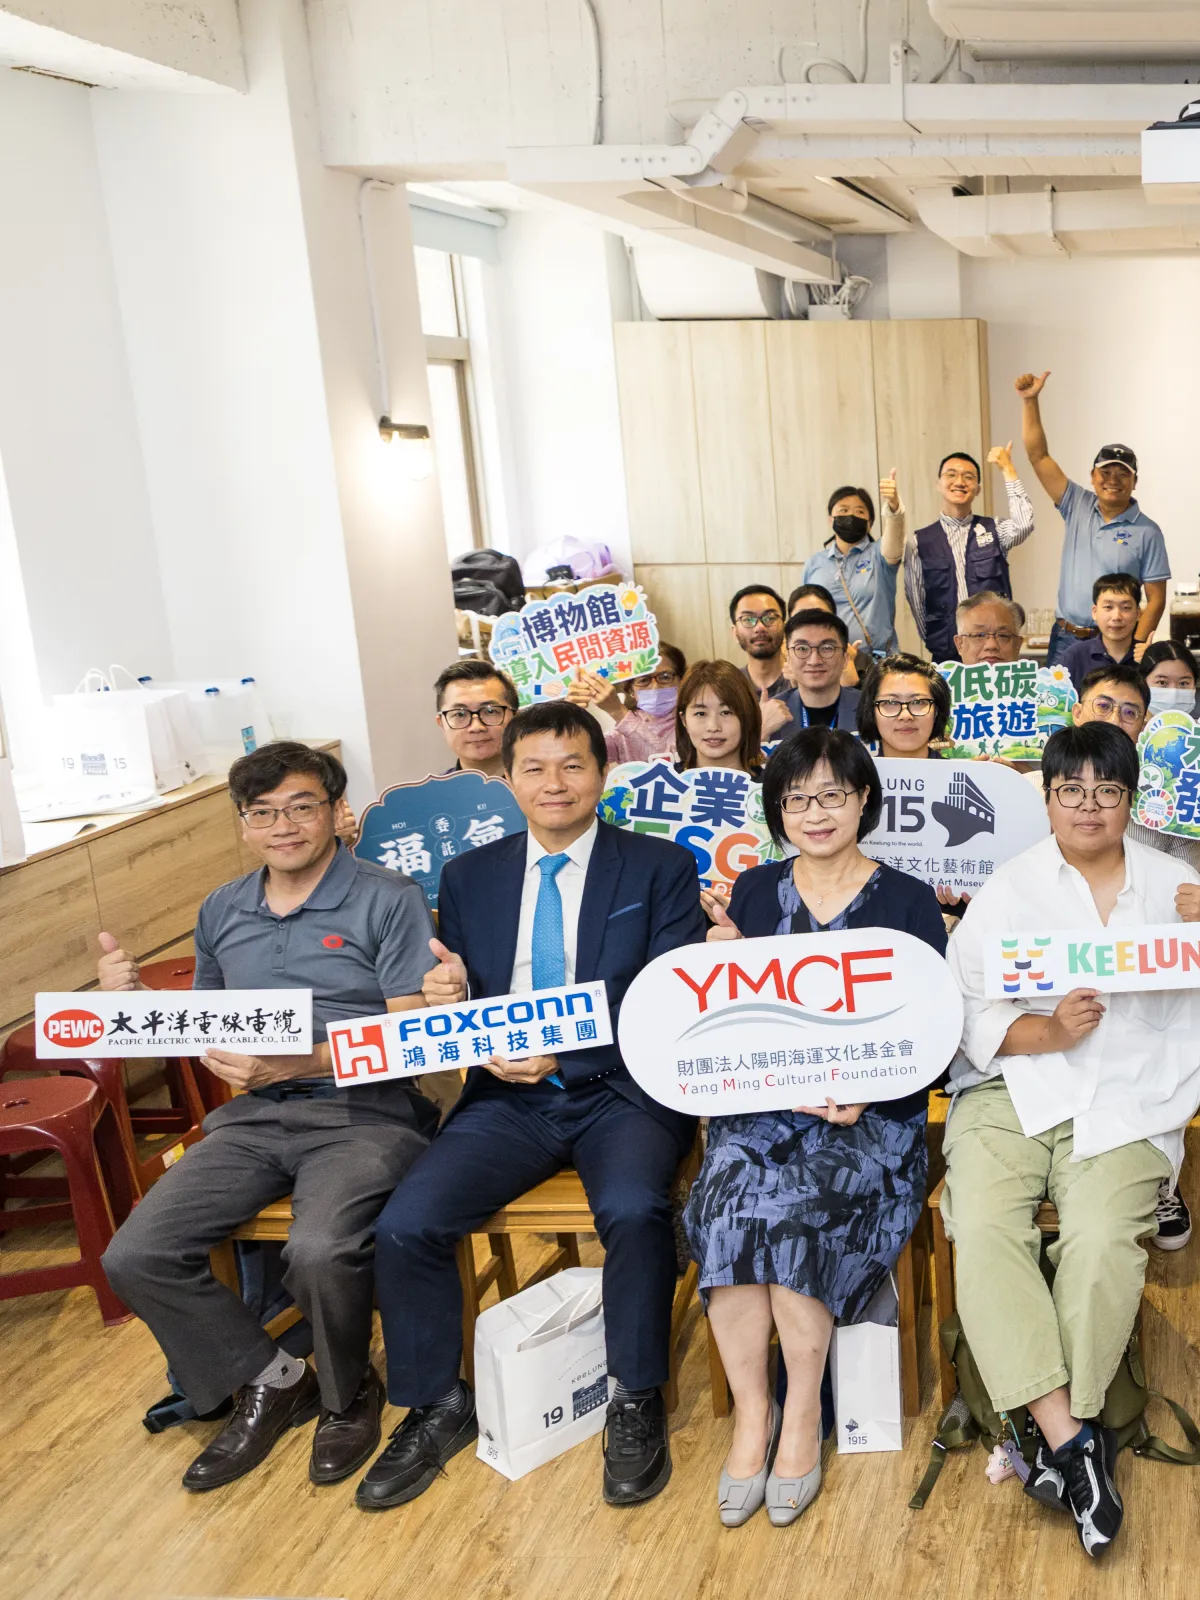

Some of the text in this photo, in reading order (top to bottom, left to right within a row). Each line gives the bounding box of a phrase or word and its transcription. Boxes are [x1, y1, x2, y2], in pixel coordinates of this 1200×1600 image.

[521, 592, 621, 648] 博物館
[502, 621, 653, 687] 導入民間資源
[949, 662, 1038, 702] 低碳
[953, 702, 1037, 740] 旅遊
[629, 763, 749, 828] 企業
[881, 778, 925, 791] UNG
[391, 821, 407, 830] HO!
[377, 832, 432, 876] 福
[938, 878, 951, 886] Art
[672, 948, 893, 1013] YMCF
[48, 1020, 101, 1039] PEWC
[147, 1037, 191, 1045] ELECTRIC
[403, 1019, 597, 1069] 鴻海科技集團
[677, 1039, 914, 1077] 財團法人陽明海運文化基金會
[679, 1064, 917, 1096] Yang Ming Cultural Foundation
[543, 1406, 563, 1428] 19
[848, 1436, 868, 1445] 1915
